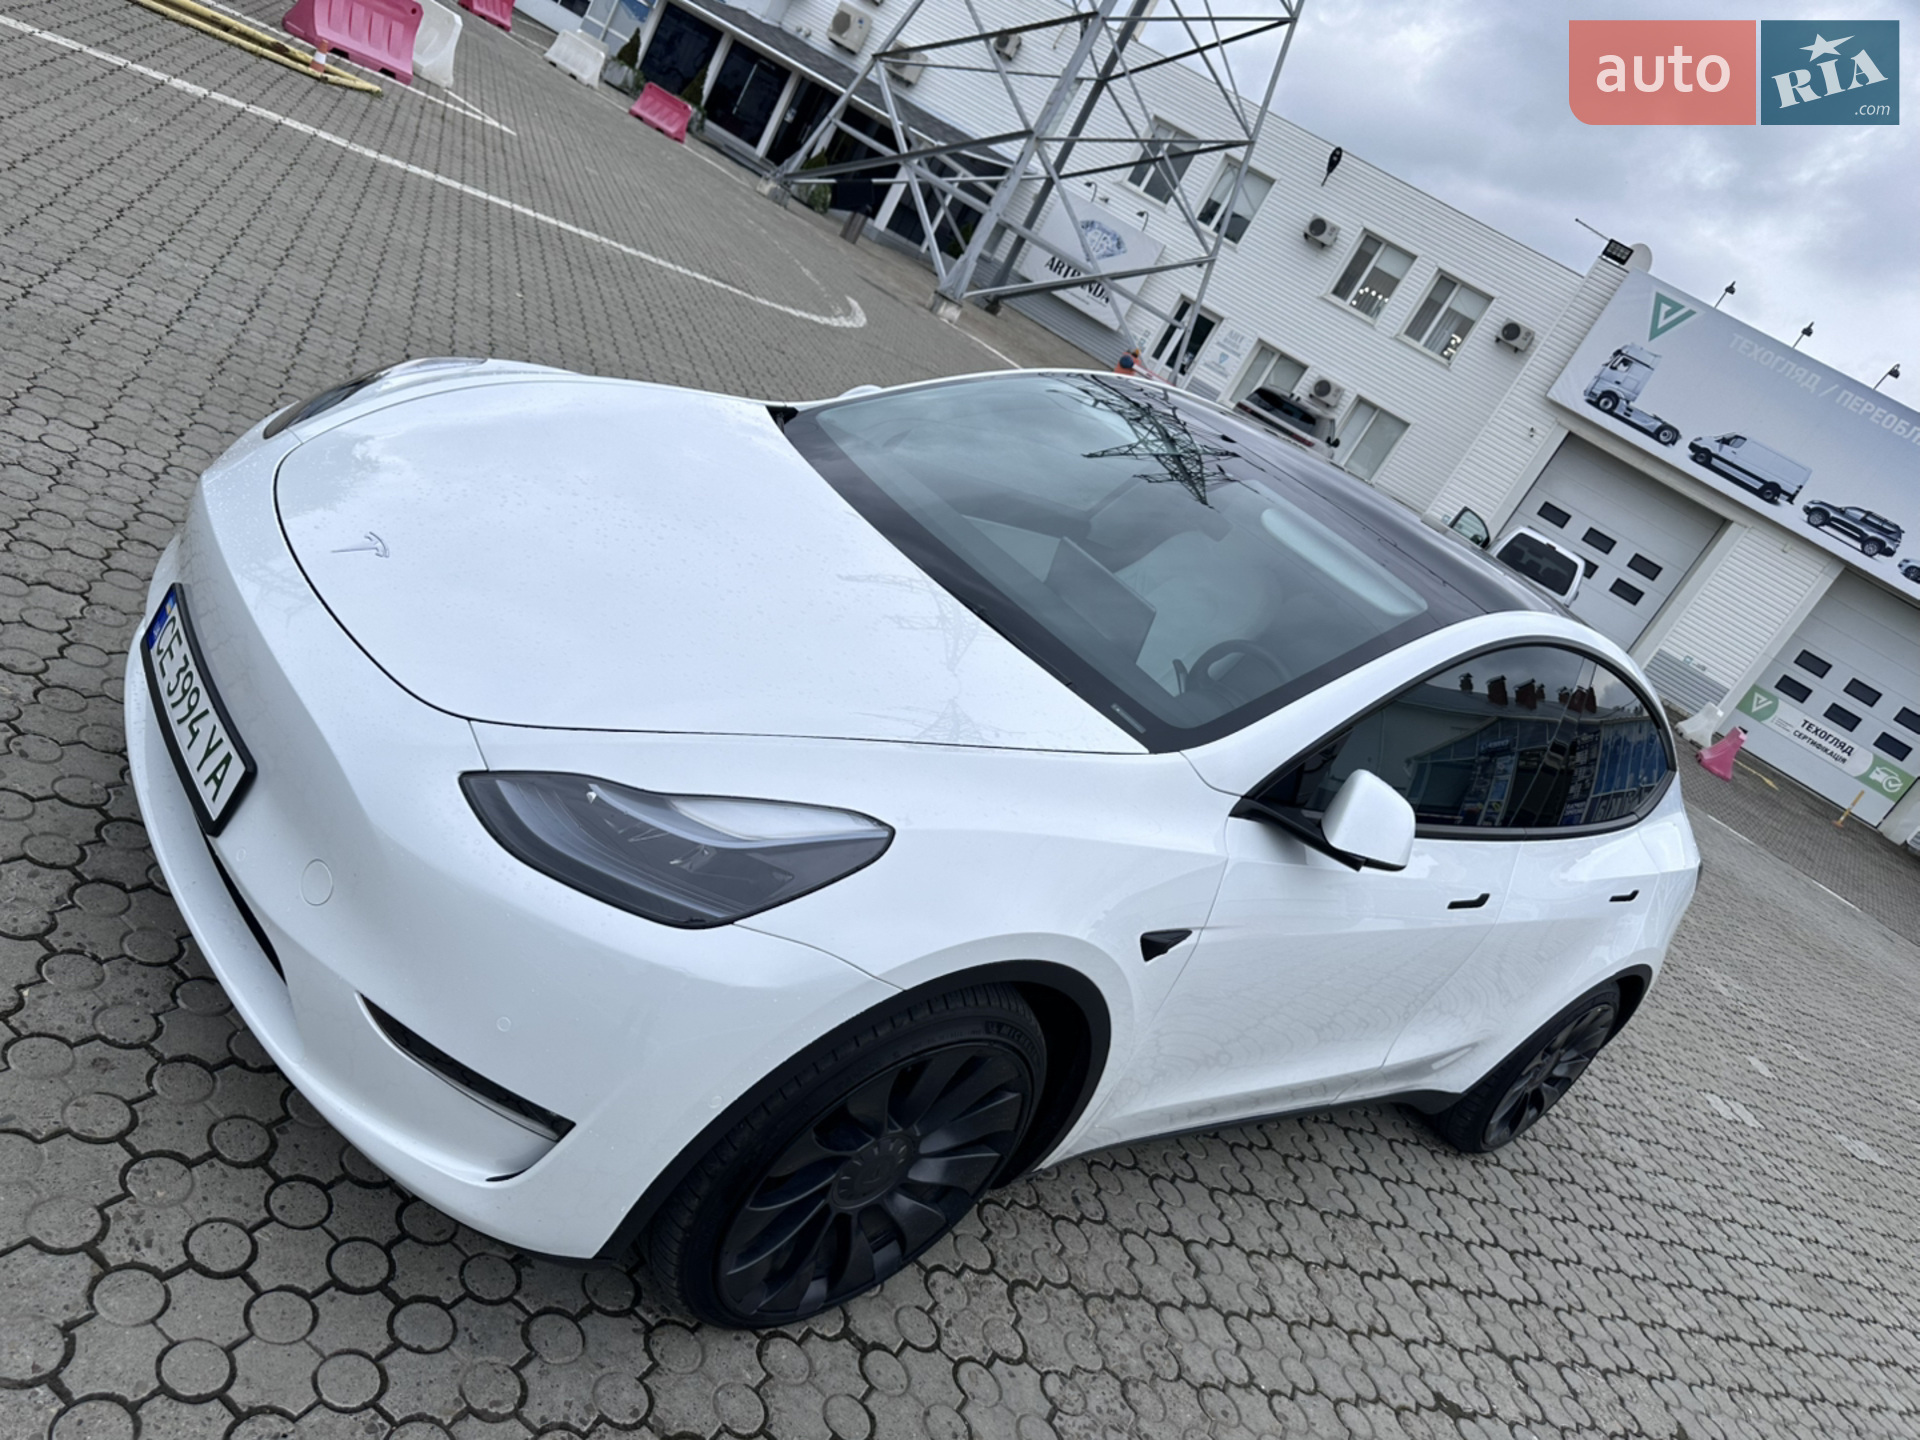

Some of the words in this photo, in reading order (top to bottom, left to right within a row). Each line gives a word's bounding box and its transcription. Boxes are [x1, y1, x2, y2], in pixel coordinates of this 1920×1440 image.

[1044, 256, 1110, 303] ARTNDA
[1729, 333, 1822, 394] ТЕХОГЛЯД
[1835, 389, 1920, 446] ПЕРЕОБЛ
[1792, 729, 1848, 765] СЕРТИФІКАЦІЯ
[1800, 719, 1855, 757] ТЕХОГЛЯД
